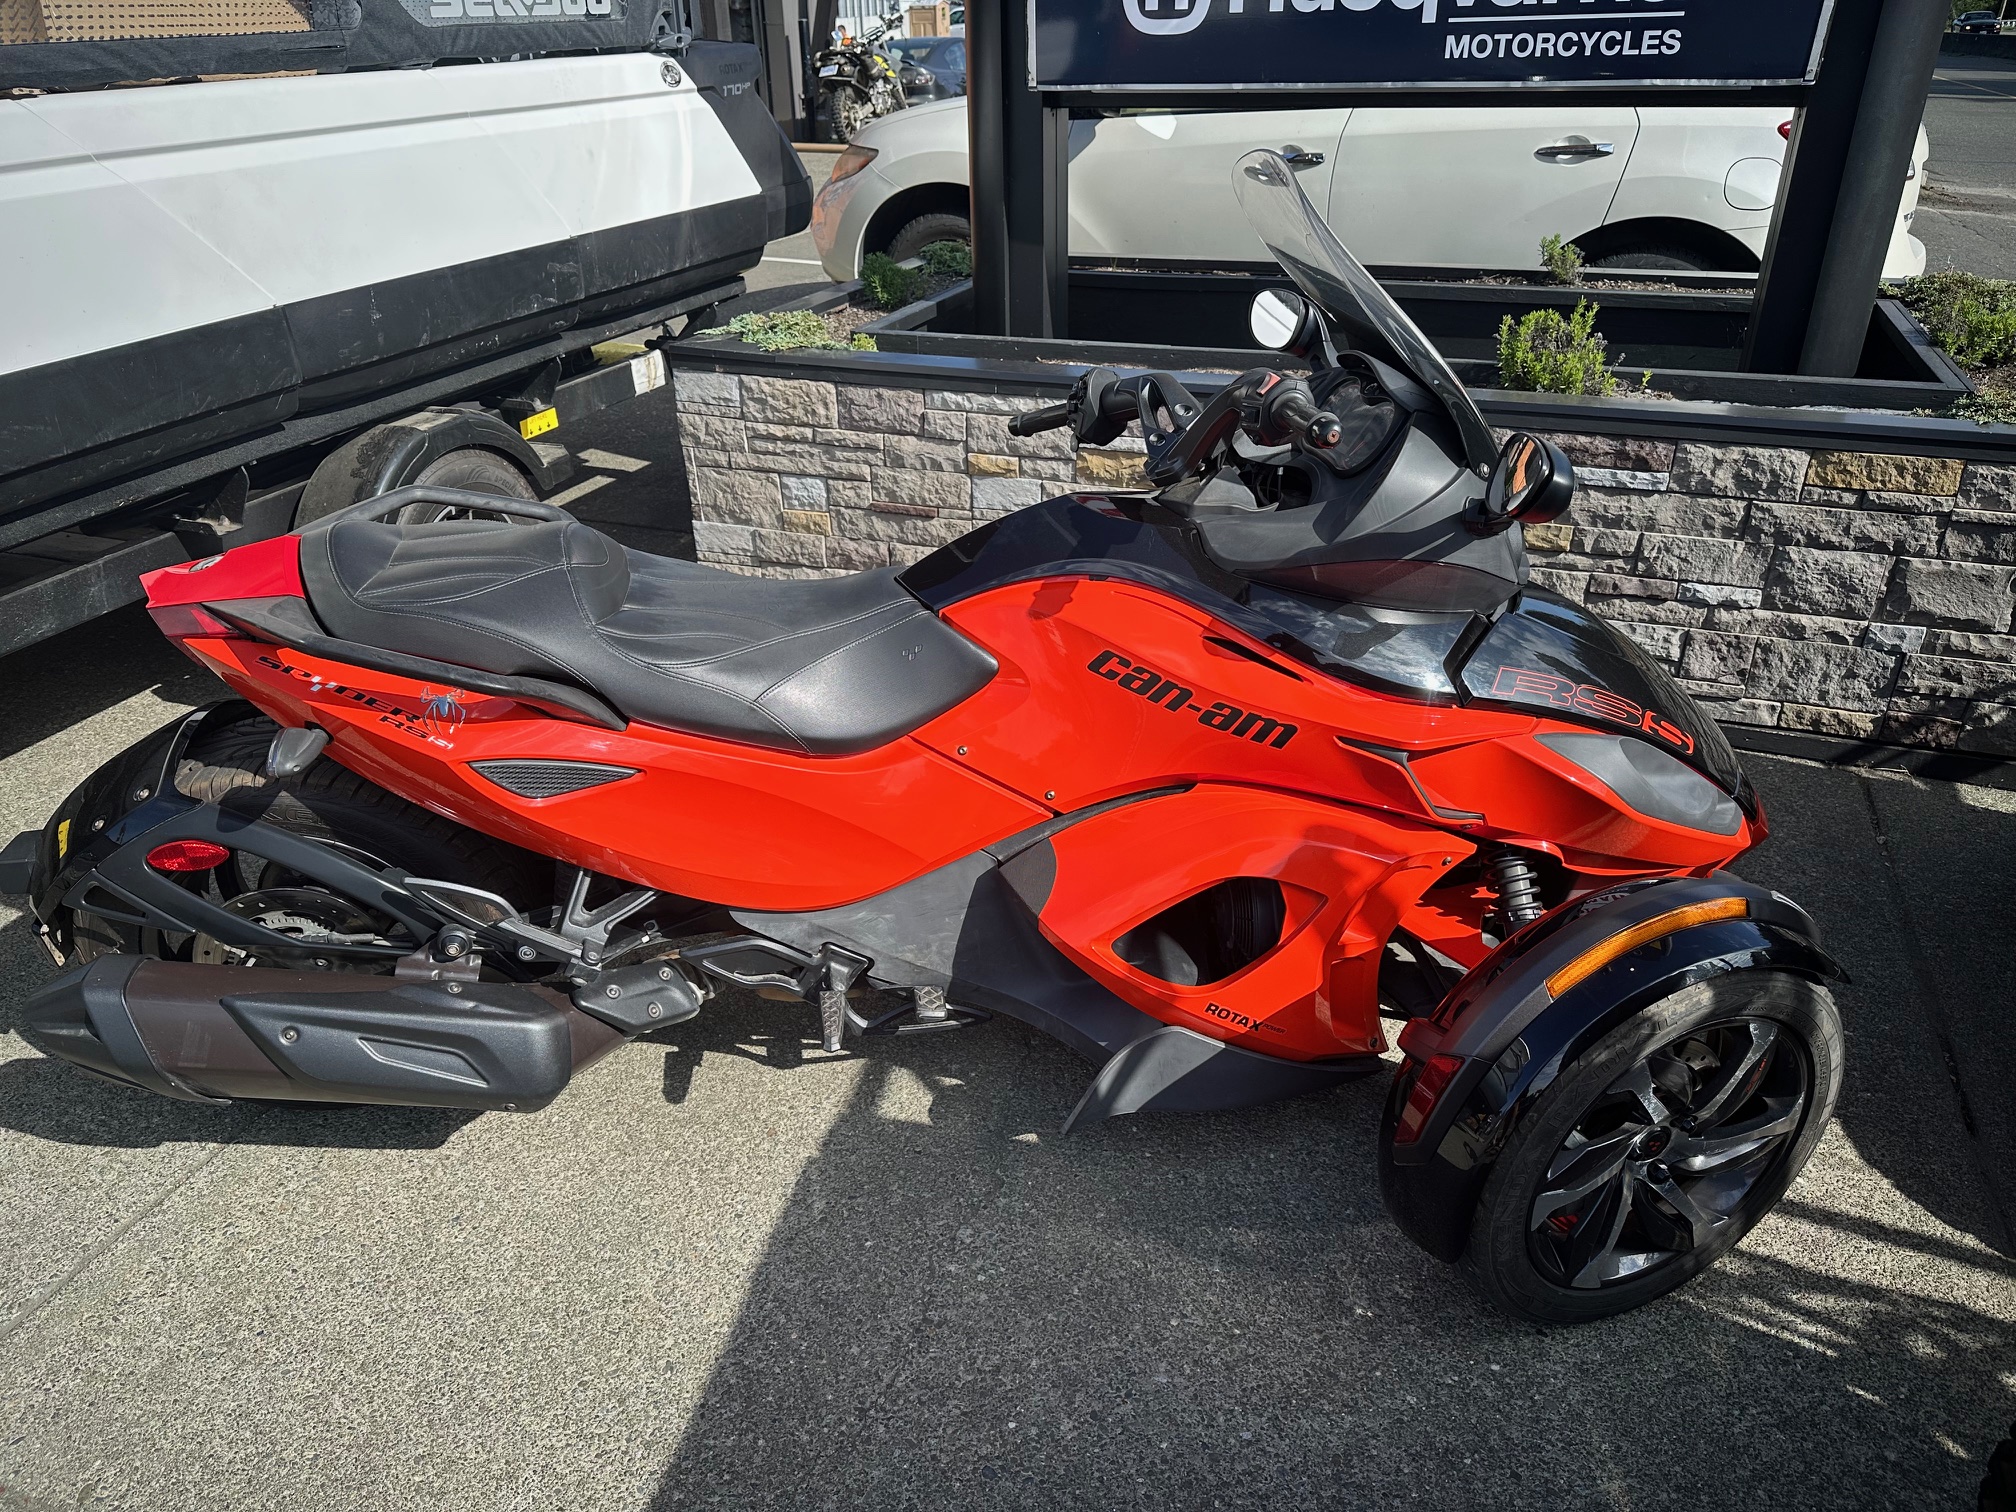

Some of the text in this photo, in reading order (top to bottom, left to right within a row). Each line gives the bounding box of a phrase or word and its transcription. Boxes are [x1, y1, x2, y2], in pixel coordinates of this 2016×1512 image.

[1444, 29, 1682, 59] MOTORCYCLES
[494, 474, 518, 495] SPECIAL
[1087, 649, 1298, 749] can-am
[1204, 1002, 1264, 1032] ROTAX
